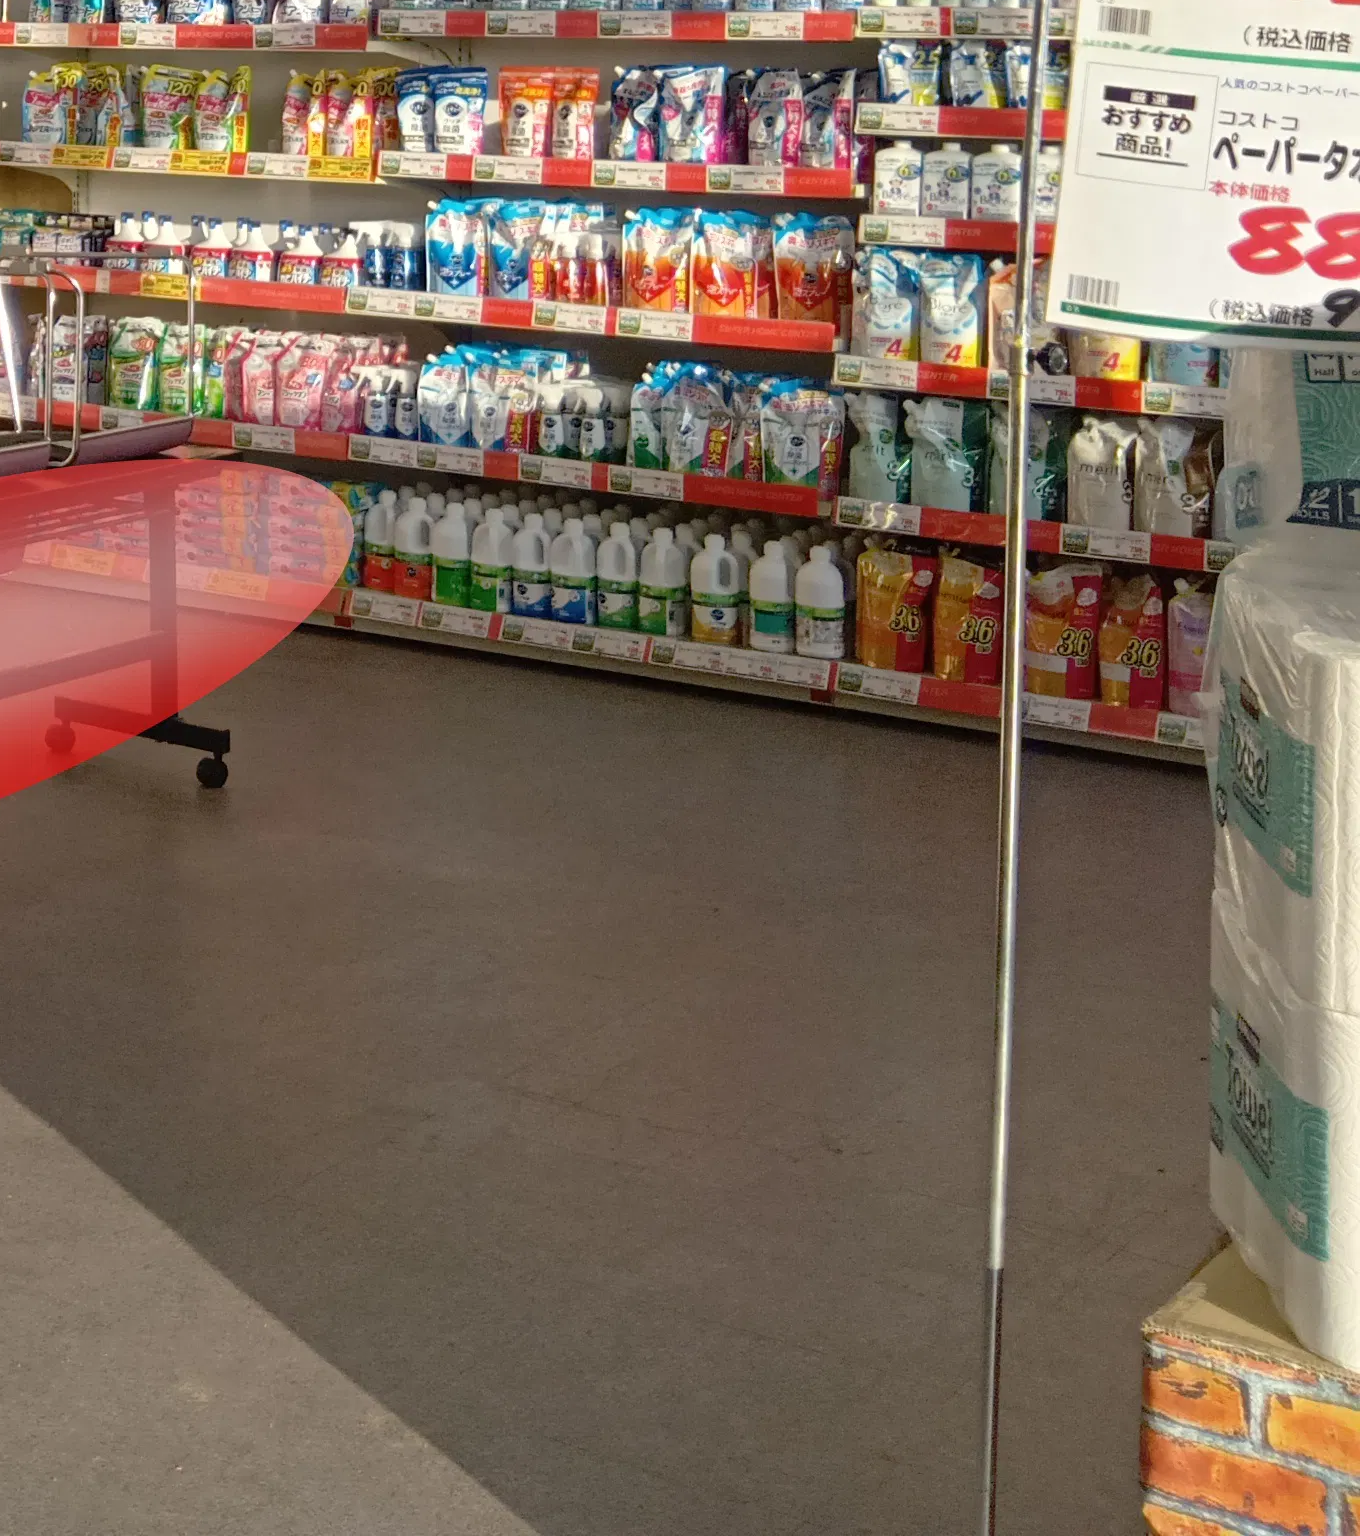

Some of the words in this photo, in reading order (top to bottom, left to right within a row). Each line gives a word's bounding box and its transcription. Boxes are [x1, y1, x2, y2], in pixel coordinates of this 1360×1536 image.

[1102, 102, 1193, 136] おすすめ
[1217, 109, 1301, 133] コストコ
[1115, 129, 1174, 159] 商品!
[1208, 178, 1291, 204] 本体価格
[886, 338, 903, 357] 4
[945, 342, 962, 362] 4
[1103, 351, 1120, 372] 4
[1313, 368, 1335, 378] Half
